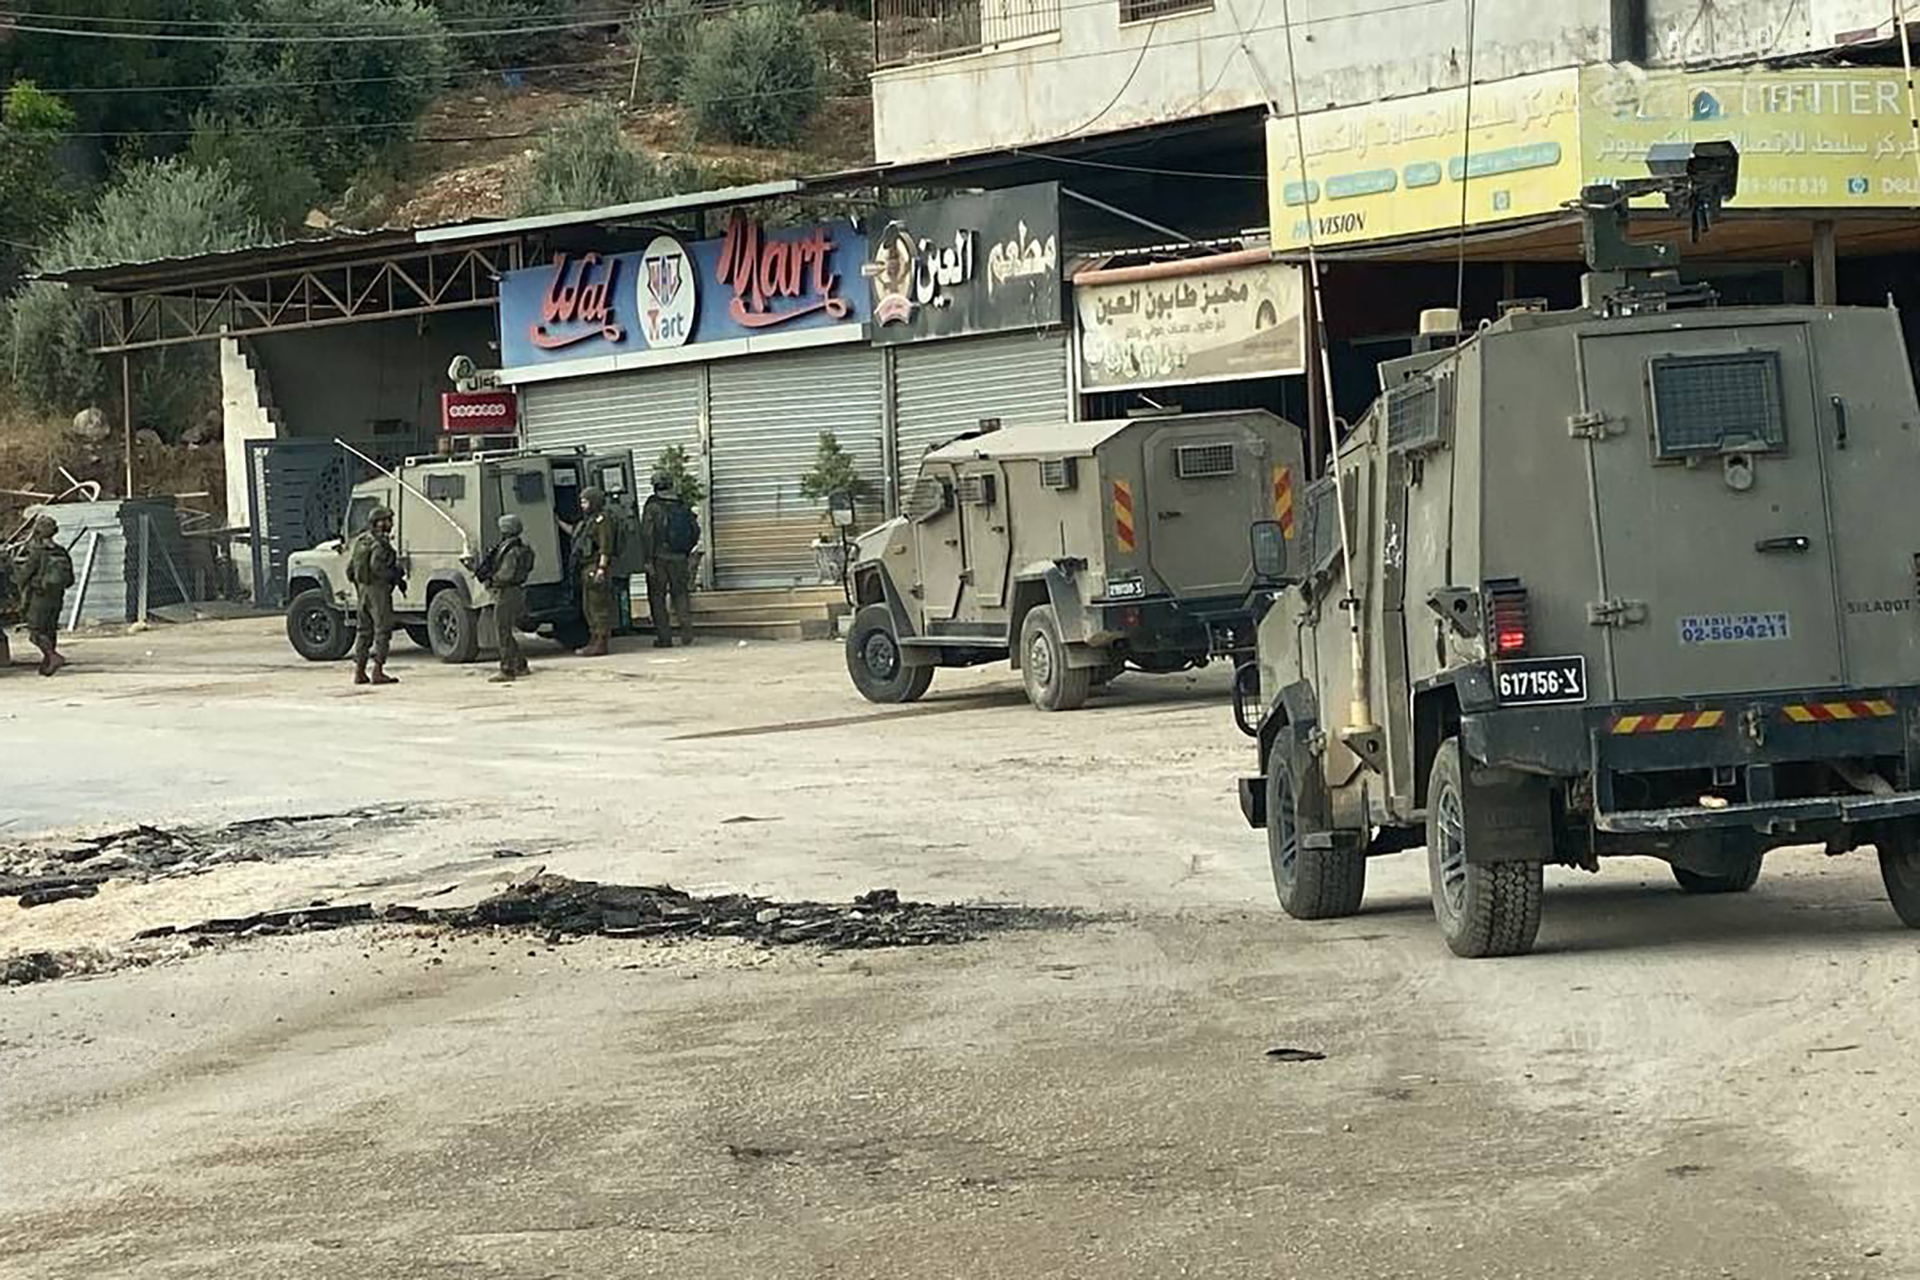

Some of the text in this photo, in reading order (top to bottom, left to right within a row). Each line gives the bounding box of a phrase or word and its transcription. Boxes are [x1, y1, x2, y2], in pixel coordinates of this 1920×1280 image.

[533, 208, 849, 348] Wal Mart
[917, 219, 1057, 308] مطعم العين
[1096, 280, 1249, 326] مخبز طابون العين
[449, 403, 507, 418] ooredoo
[1682, 622, 1788, 643] 02-5694211
